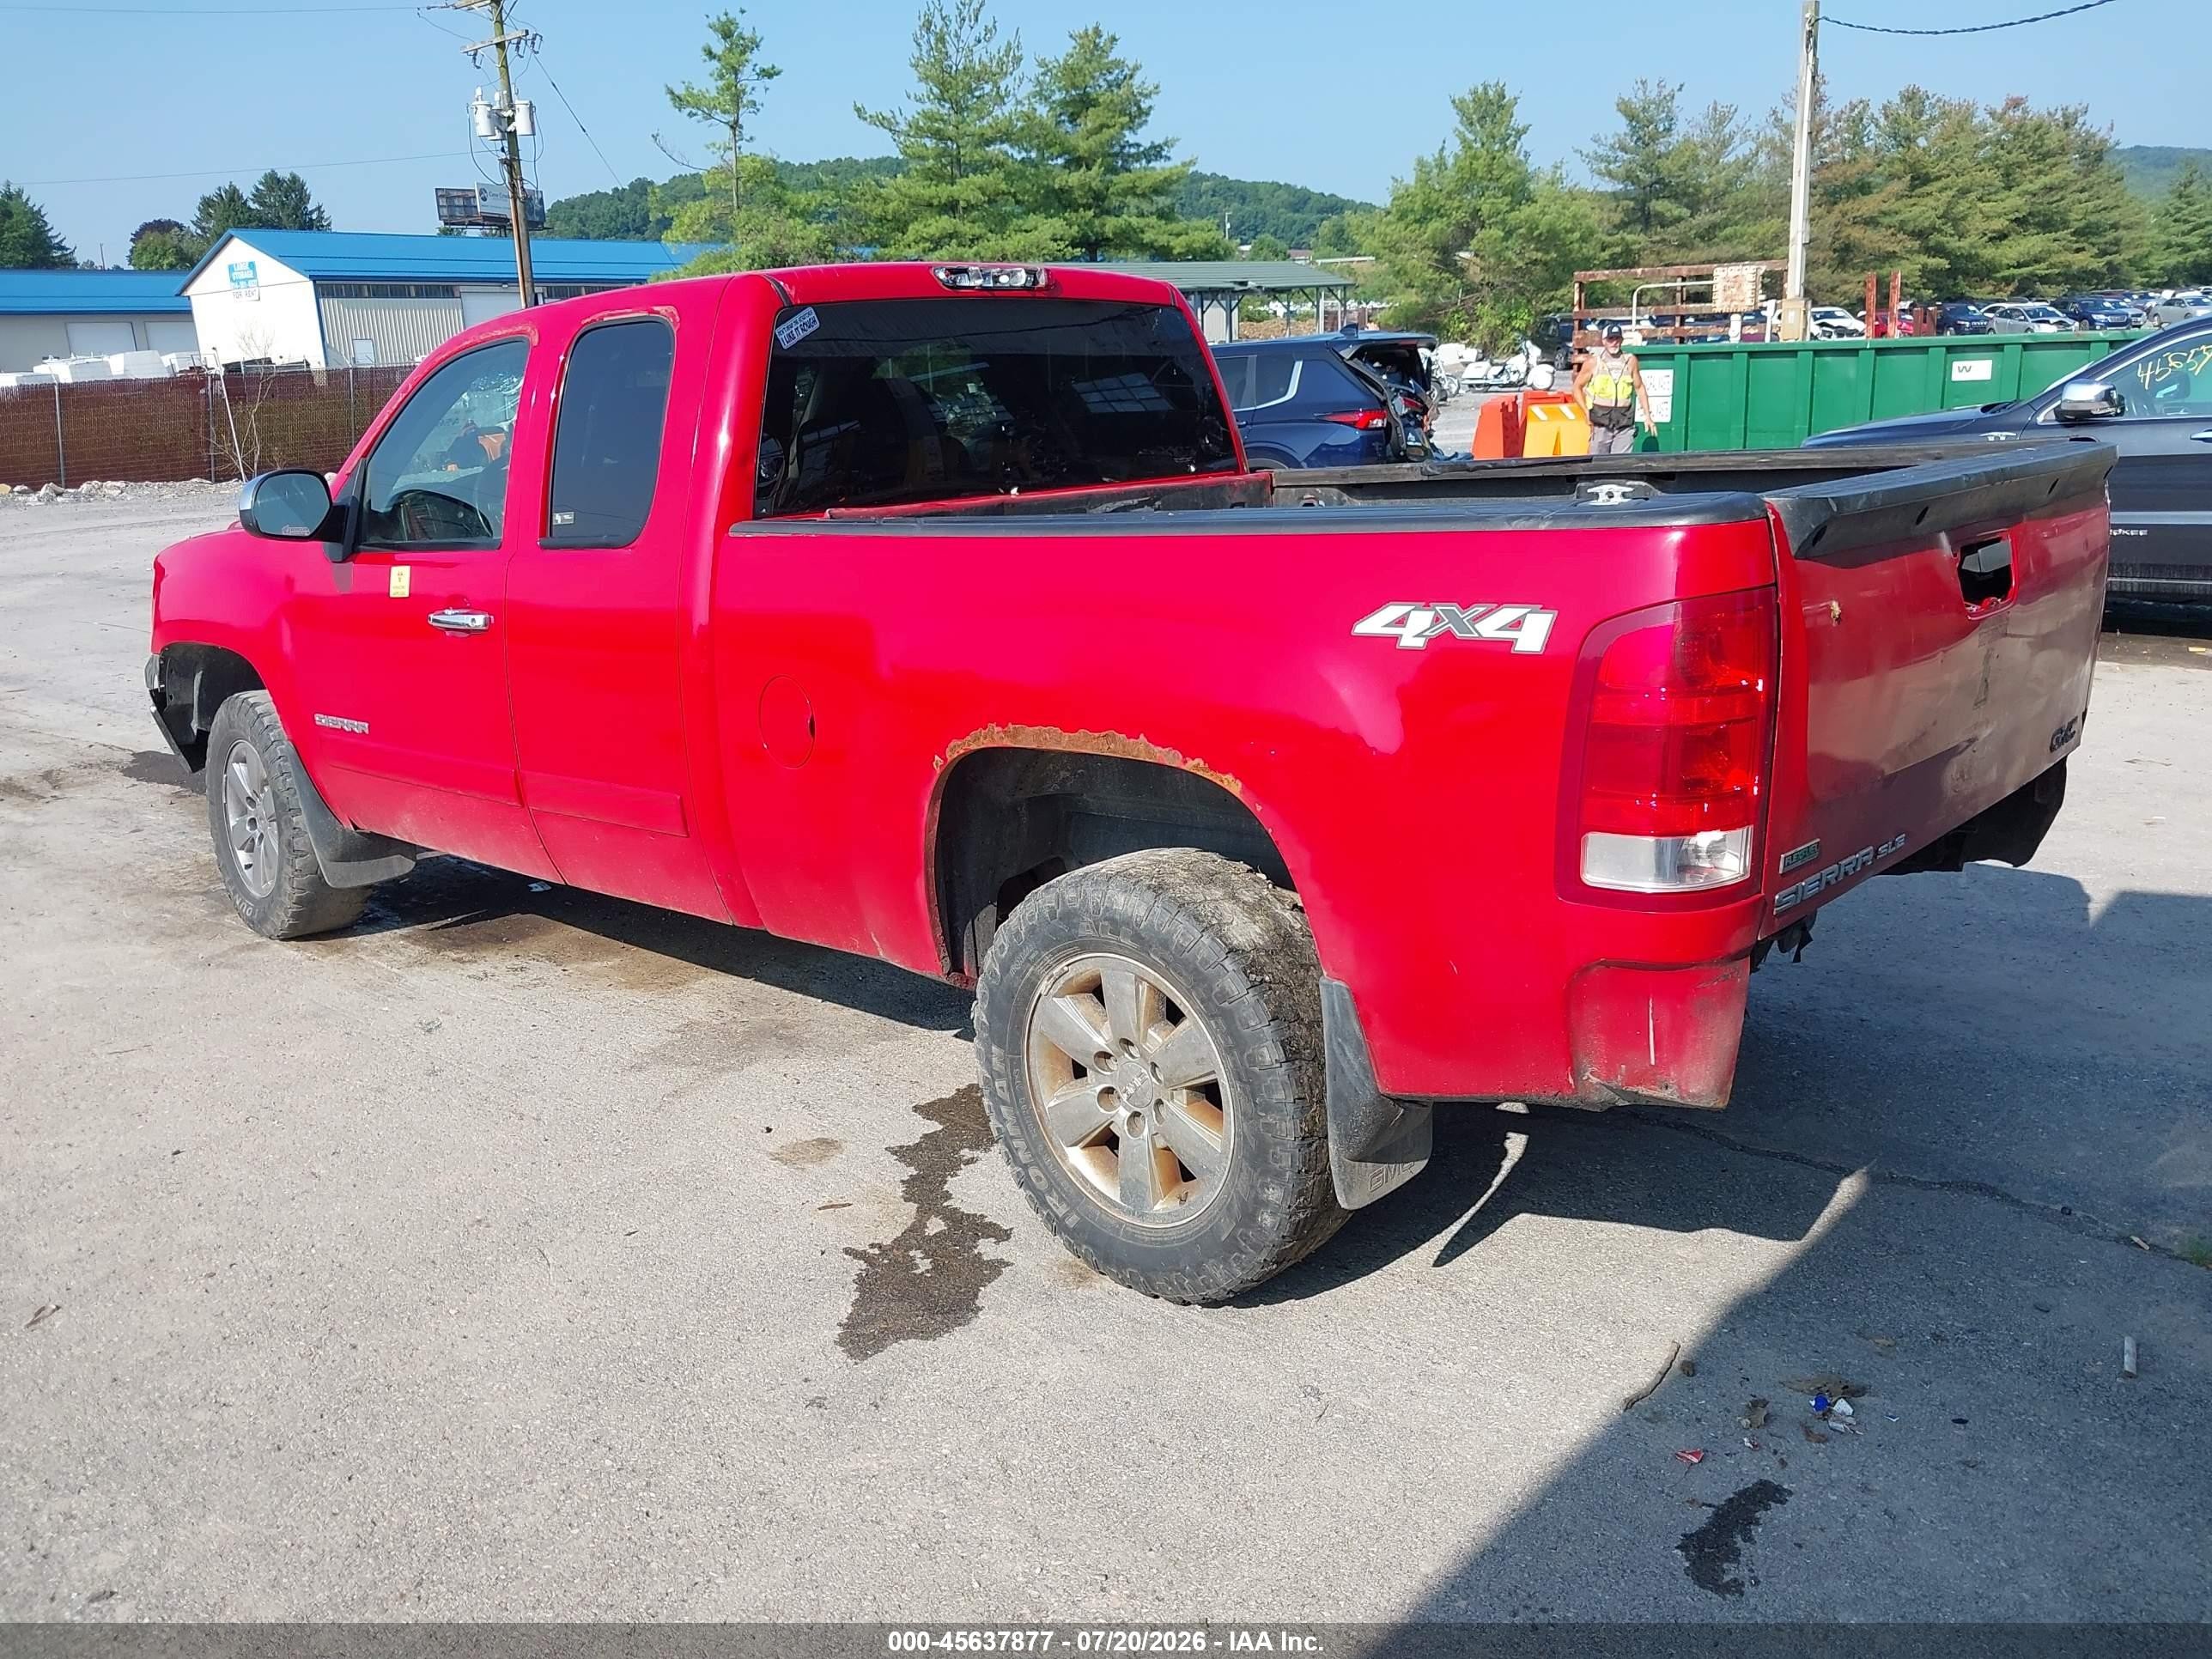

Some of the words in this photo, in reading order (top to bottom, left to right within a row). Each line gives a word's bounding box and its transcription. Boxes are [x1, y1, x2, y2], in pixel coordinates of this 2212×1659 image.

[314, 714, 369, 734] SIERRA
[1772, 845, 1875, 916] SIERRA
[1876, 833, 1906, 860] SLE
[991, 1043, 1081, 1229] IRONMAN
[1368, 1161, 1415, 1193] GMC
